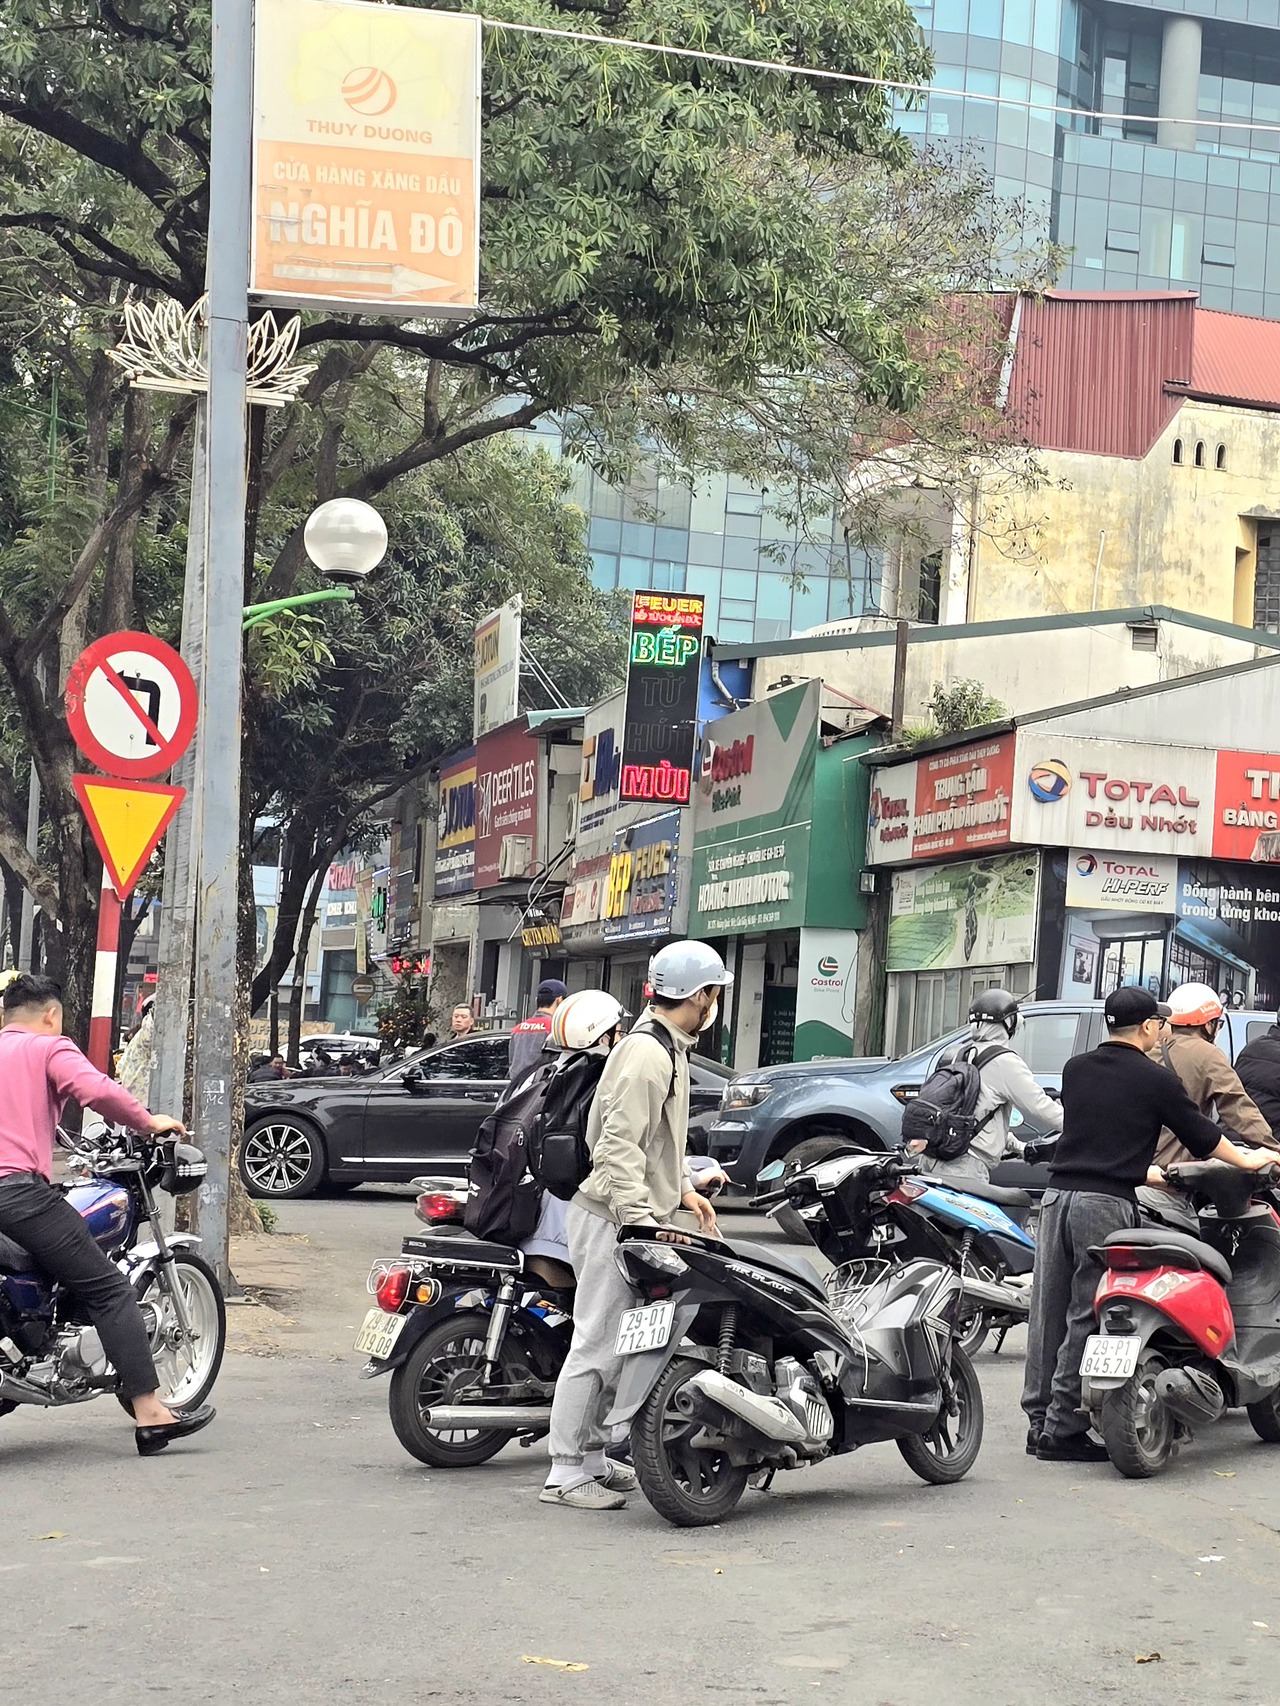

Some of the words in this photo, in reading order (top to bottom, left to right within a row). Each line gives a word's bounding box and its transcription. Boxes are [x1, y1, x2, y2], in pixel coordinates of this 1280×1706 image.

[306, 119, 358, 136] THUY
[364, 125, 433, 144] DUONG
[273, 155, 310, 182] CỬA
[317, 162, 365, 188] HÀNG
[371, 168, 420, 192] XĂNG
[426, 171, 461, 196] DẦU
[269, 199, 398, 251] NGHĨA
[409, 207, 463, 257] ĐÔ
[632, 625, 699, 666] BẾP
[934, 773, 965, 801] TRUNG
[965, 763, 988, 794] TÂM
[1080, 772, 1200, 808] TOTAL
[1086, 806, 1133, 830] Dầu
[1141, 815, 1197, 835] Nhớt
[1102, 861, 1159, 877] TOTAL
[1102, 878, 1169, 896] HI-PERF
[1182, 882, 1217, 902] Đồng
[1220, 886, 1252, 902] hành
[1256, 889, 1280, 904] bên
[1182, 902, 1217, 921] trong
[1220, 902, 1251, 922] từng
[811, 978, 843, 987] Castrol
[520, 1022, 546, 1030] TOTAL
[366, 1311, 399, 1334] 29-AB
[355, 1333, 393, 1356] 019.08
[618, 1326, 666, 1352] 712.10
[1093, 1339, 1130, 1356] 29-P1
[1084, 1357, 1131, 1374] 845.70
